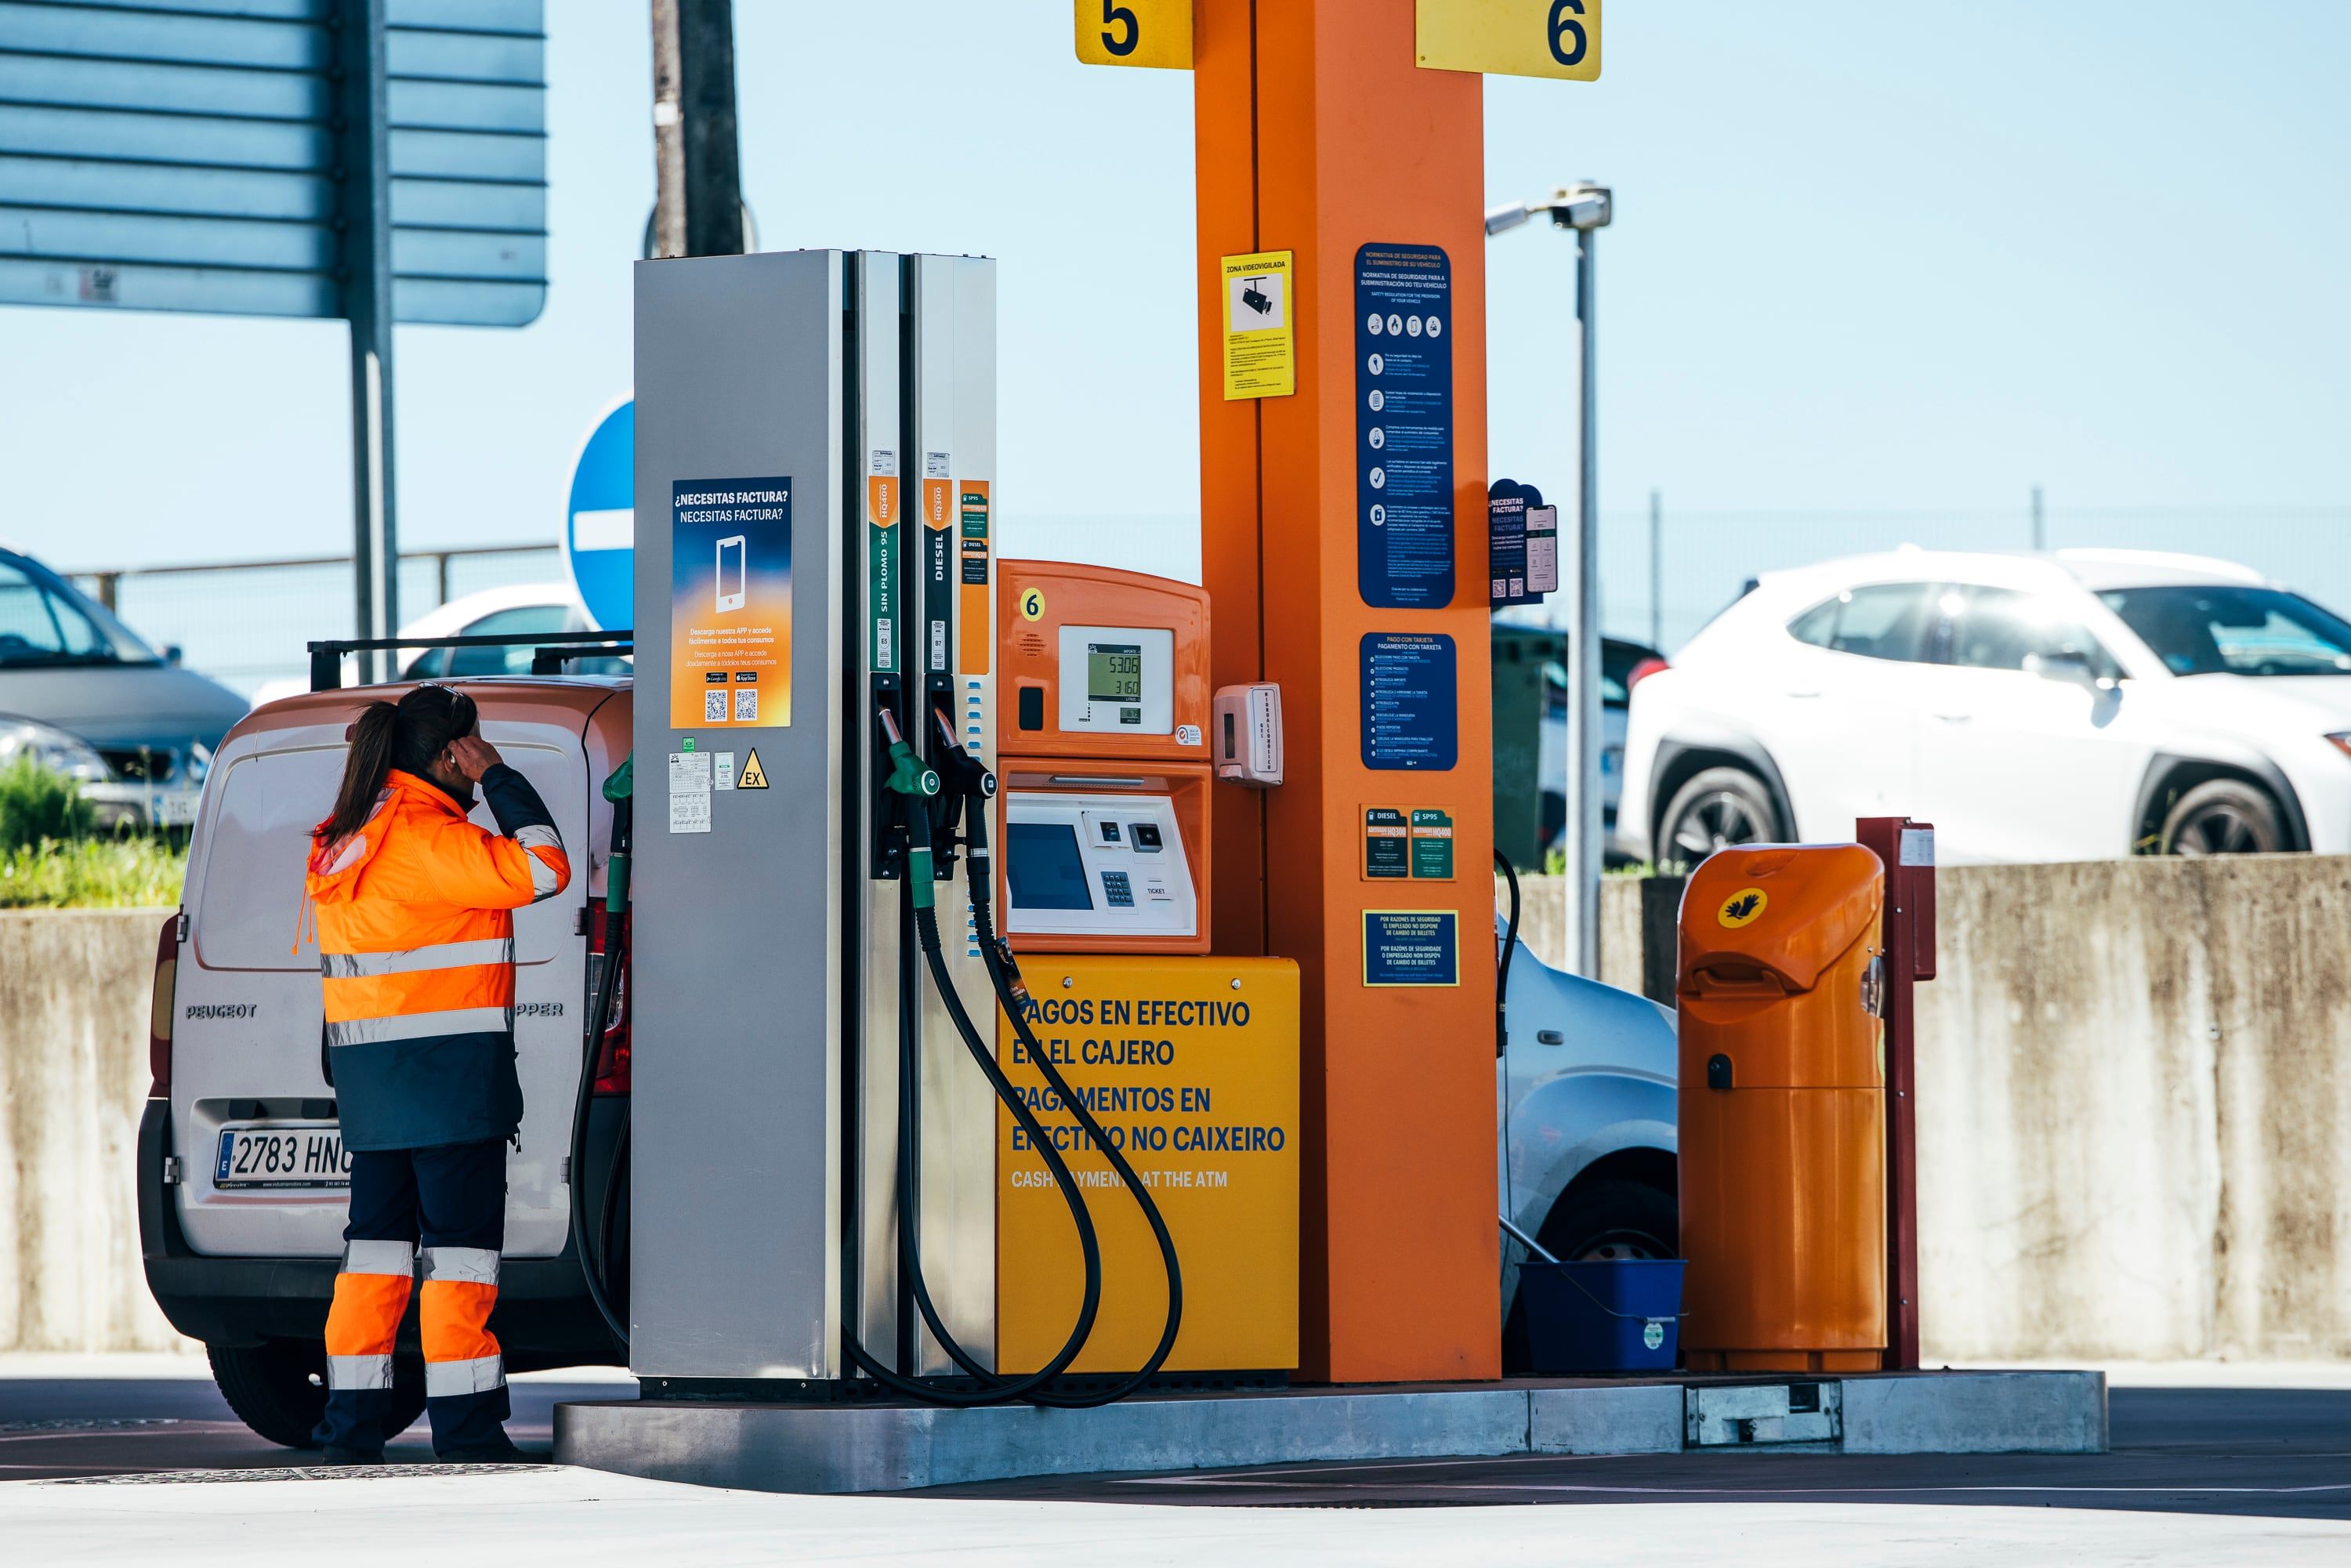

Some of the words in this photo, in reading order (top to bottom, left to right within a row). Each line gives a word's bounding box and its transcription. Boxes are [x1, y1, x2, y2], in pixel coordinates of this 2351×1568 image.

[1101, 0, 1139, 56] 5
[1548, 0, 1588, 66] 6
[1242, 261, 1285, 271] VIDEOVIGILADA
[675, 492, 735, 507] ¿NECESITAS
[737, 491, 788, 504] FACTURA?
[680, 509, 733, 523] NECESITAS
[734, 509, 783, 520] FACTURA?
[881, 531, 887, 545] 95
[1027, 594, 1038, 615] 6
[745, 772, 760, 785] EX
[1388, 827, 1406, 837] HQ300
[1433, 828, 1451, 838] HQ400
[186, 1004, 257, 1019] PEUGEOT
[1100, 1000, 1130, 1025] EN
[1137, 1001, 1250, 1027] EFECTIVO
[1050, 1039, 1076, 1064] EL
[1081, 1039, 1174, 1066] CAJERO
[1013, 1087, 1175, 1112] AGMENTOS
[1181, 1088, 1210, 1112] EN
[1132, 1126, 1167, 1151] NO
[1173, 1126, 1285, 1152] CAIXEIRO
[235, 1136, 297, 1173] 2783
[222, 1161, 227, 1171] E
[1012, 1171, 1053, 1187] CASH
[1057, 1171, 1137, 1187] YMEN
[1142, 1171, 1161, 1187] AT
[1163, 1171, 1192, 1187] THE
[1195, 1171, 1227, 1187] ATM
